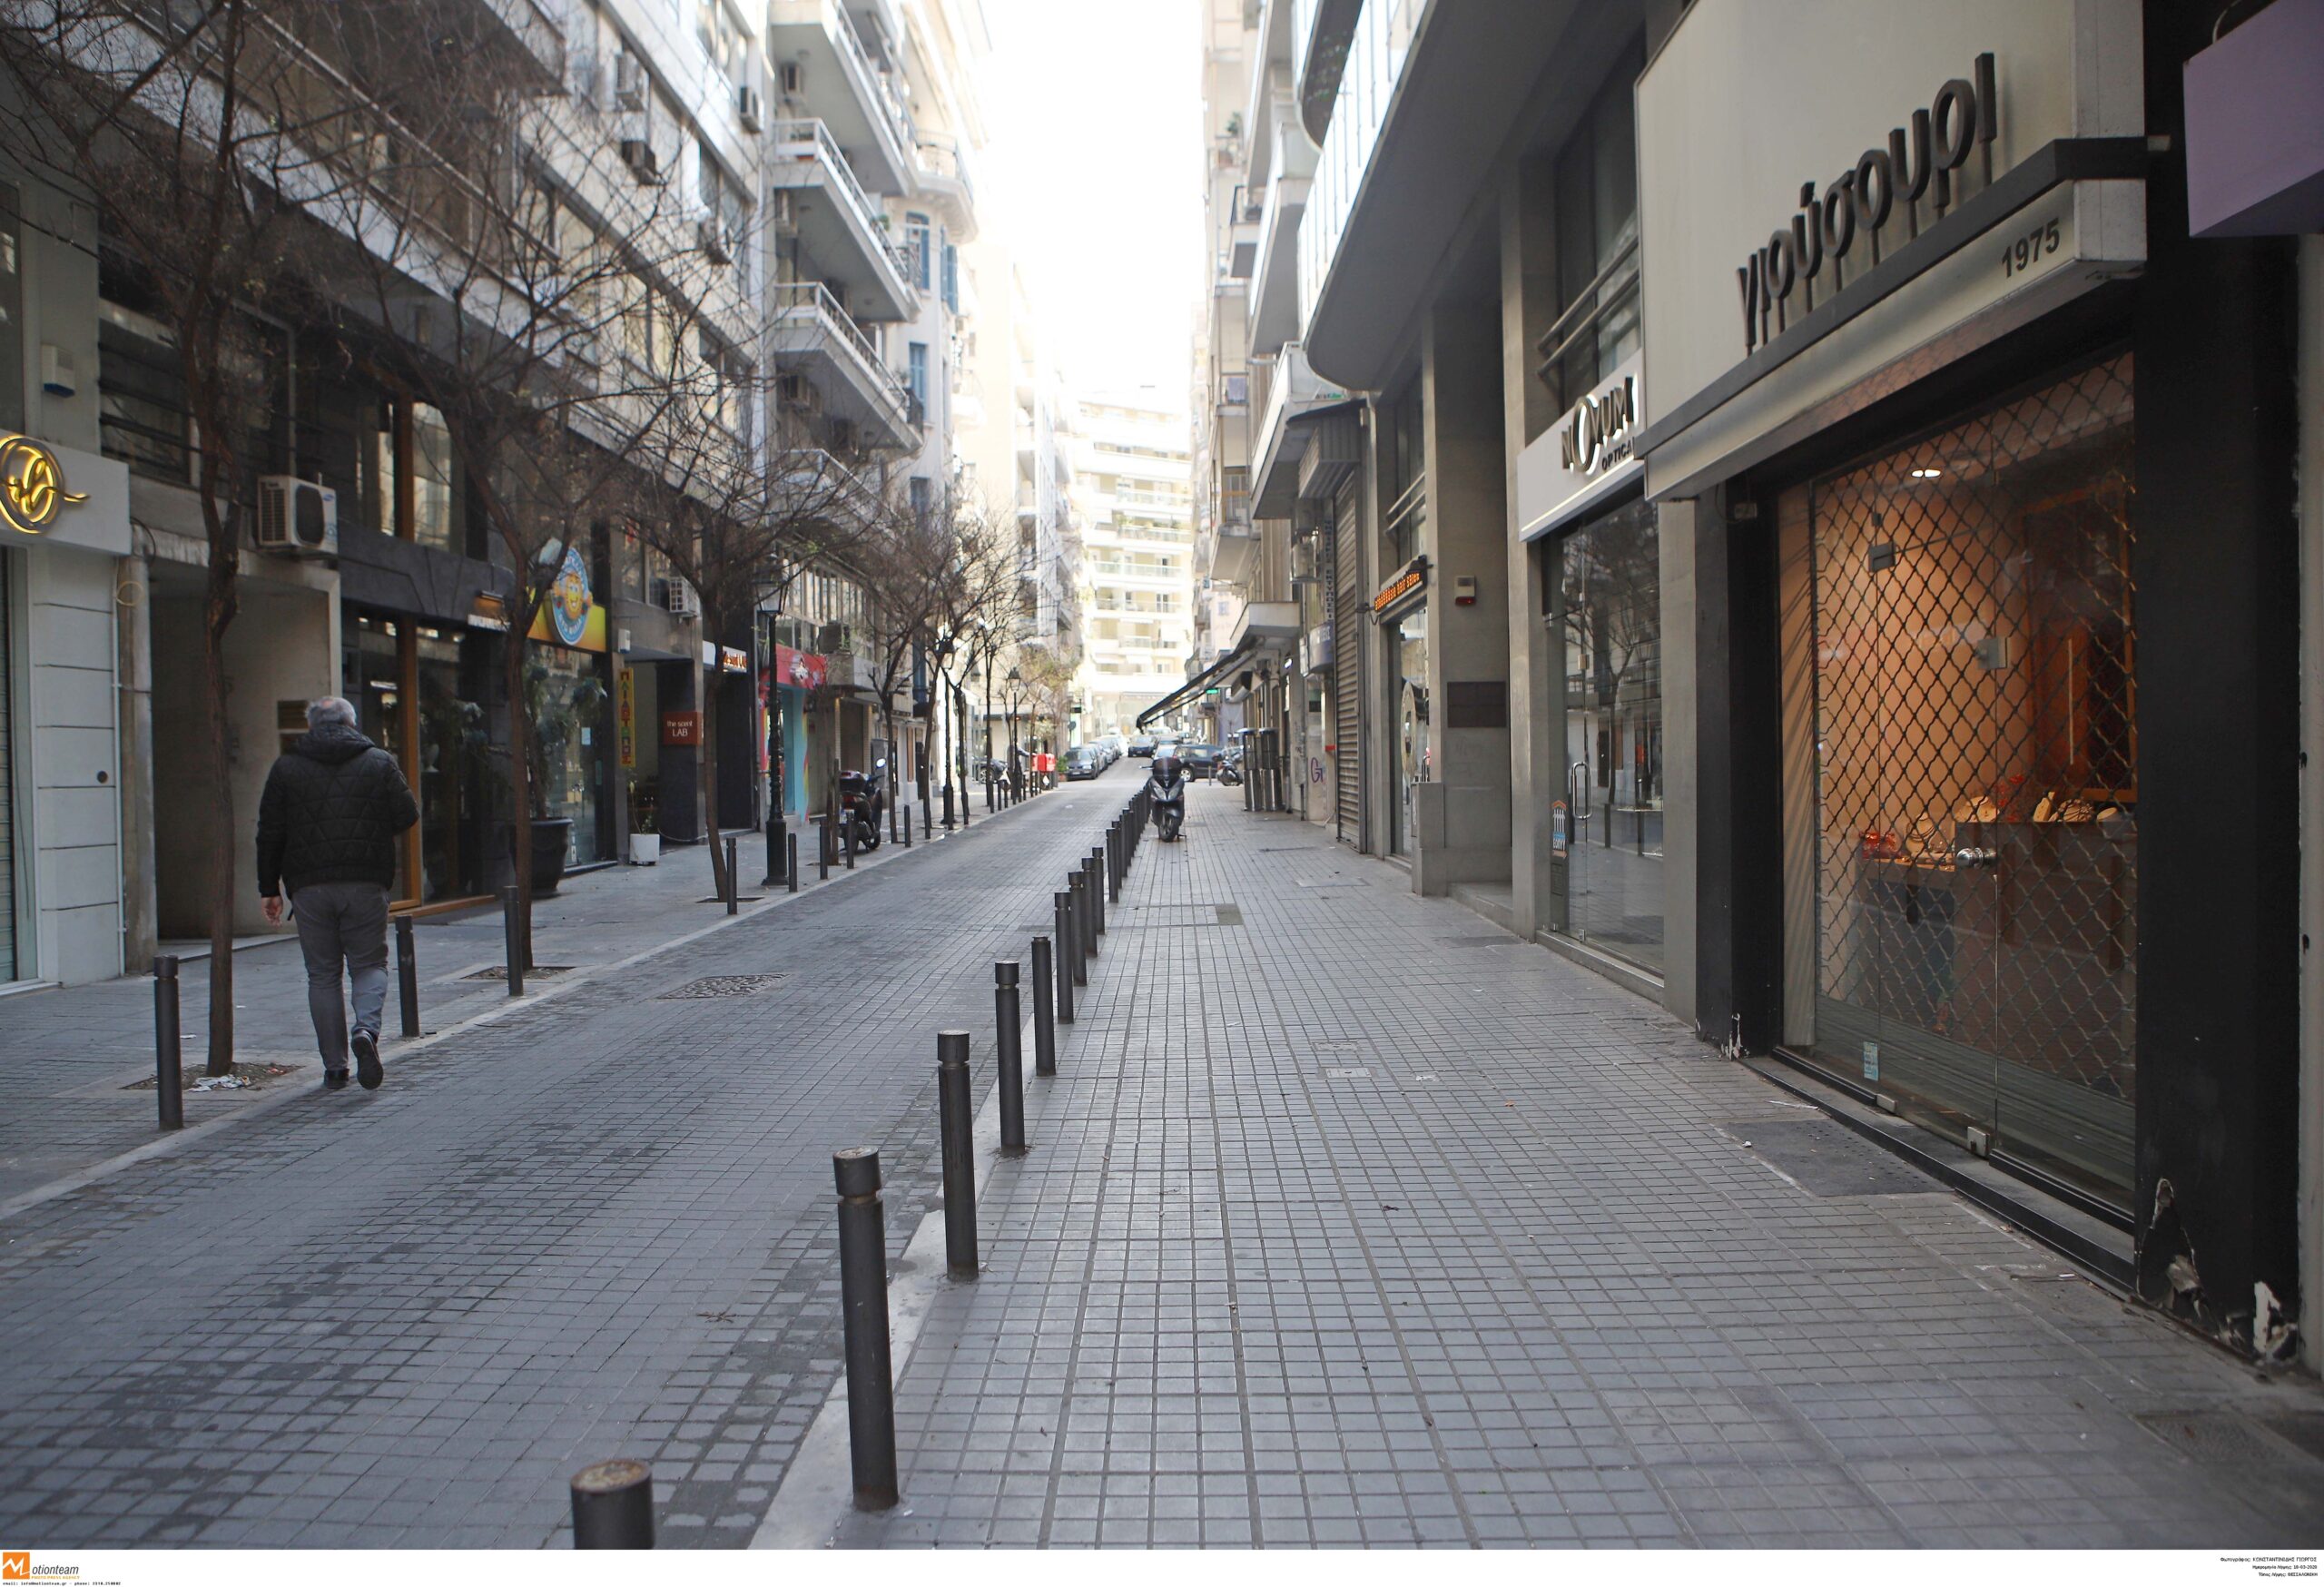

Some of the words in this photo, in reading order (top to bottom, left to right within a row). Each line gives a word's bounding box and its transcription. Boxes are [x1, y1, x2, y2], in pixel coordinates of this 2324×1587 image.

[1737, 52, 1997, 346] γιούσουρι
[2001, 217, 2061, 278] 1975
[1561, 375, 1636, 473] NOVUM
[672, 727, 688, 737] LAB
